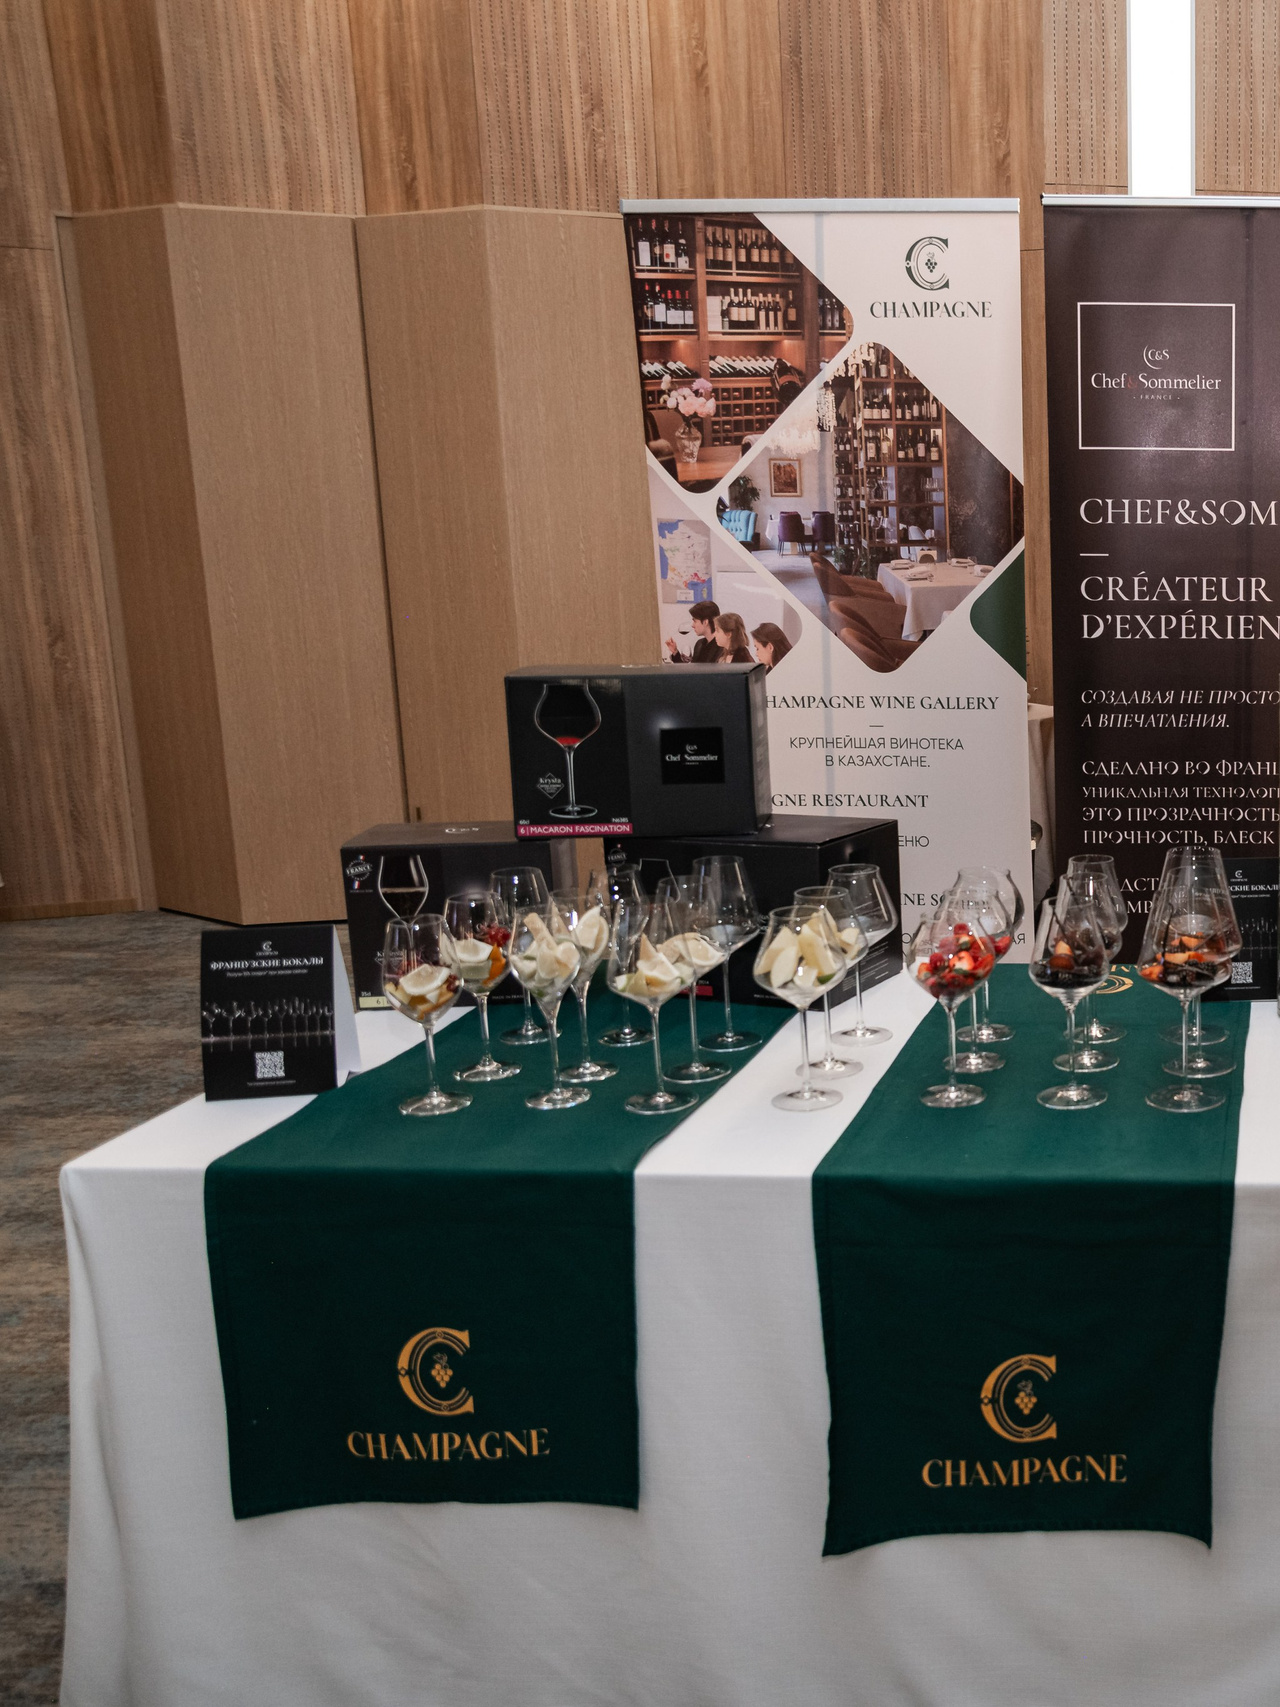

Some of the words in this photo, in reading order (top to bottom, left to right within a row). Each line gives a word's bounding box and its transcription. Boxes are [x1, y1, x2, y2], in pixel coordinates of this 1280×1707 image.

[870, 301, 992, 318] CHAMPAGNE
[1080, 571, 1273, 602] CRÉATEUR
[766, 695, 865, 709] HAMPAGNE
[869, 696, 915, 710] WINE
[920, 696, 999, 711] GALLERY
[1081, 690, 1175, 706] СОЗДАВАЯ
[1180, 690, 1203, 704] НЕ
[1208, 690, 1280, 705] ПРОСТО
[1081, 714, 1093, 727] А
[1099, 713, 1231, 728] ВПЕЧАТЛЕНИЯ.
[789, 735, 886, 750] КРУПНЕЙШАЯ
[890, 737, 964, 751] ВИНОТЕКА
[825, 755, 835, 767] В
[838, 755, 931, 768] КАЗАХСТАНЕ.
[1082, 760, 1179, 777] СДЕЛАНО
[1185, 760, 1210, 776] ВО
[1082, 786, 1188, 799] УНИКАЛЬНАЯ
[812, 794, 929, 808] RESTAURANT
[1082, 807, 1121, 823] ЭТО
[1127, 806, 1280, 822] ПРОЗРАЧНОСТЬ
[530, 826, 573, 834] MACARON
[575, 824, 630, 834] FASCINATION
[898, 835, 930, 847] ЕНЮ
[1084, 829, 1207, 847] ПРОЧНОСТЬ,
[1214, 829, 1275, 845] БЛЕСК
[210, 959, 280, 970] ФРАНЦУЗСКИЕ
[283, 957, 324, 967] БОКАЛЫ
[347, 1428, 550, 1461] CHAMPAGNE
[922, 1454, 1127, 1488] CHAMPAGNE
